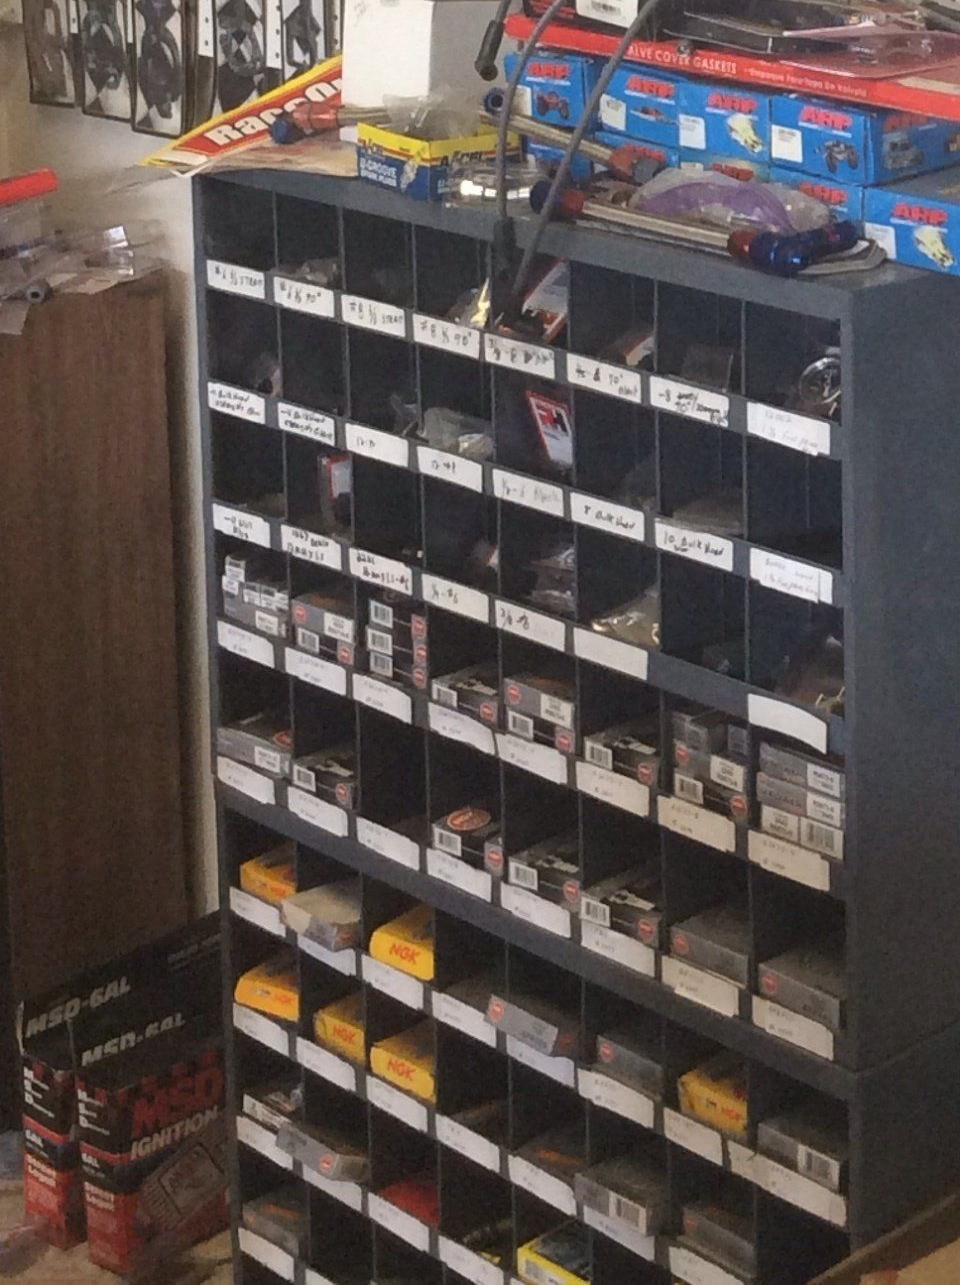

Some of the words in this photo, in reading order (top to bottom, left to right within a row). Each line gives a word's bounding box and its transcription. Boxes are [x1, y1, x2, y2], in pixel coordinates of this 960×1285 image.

[626, 44, 653, 60] ALVE
[654, 49, 691, 66] COVER
[692, 55, 738, 75] GASKETS
[389, 942, 421, 965] NGK
[386, 1058, 416, 1082] NGK
[130, 1106, 219, 1161] IGNITION
